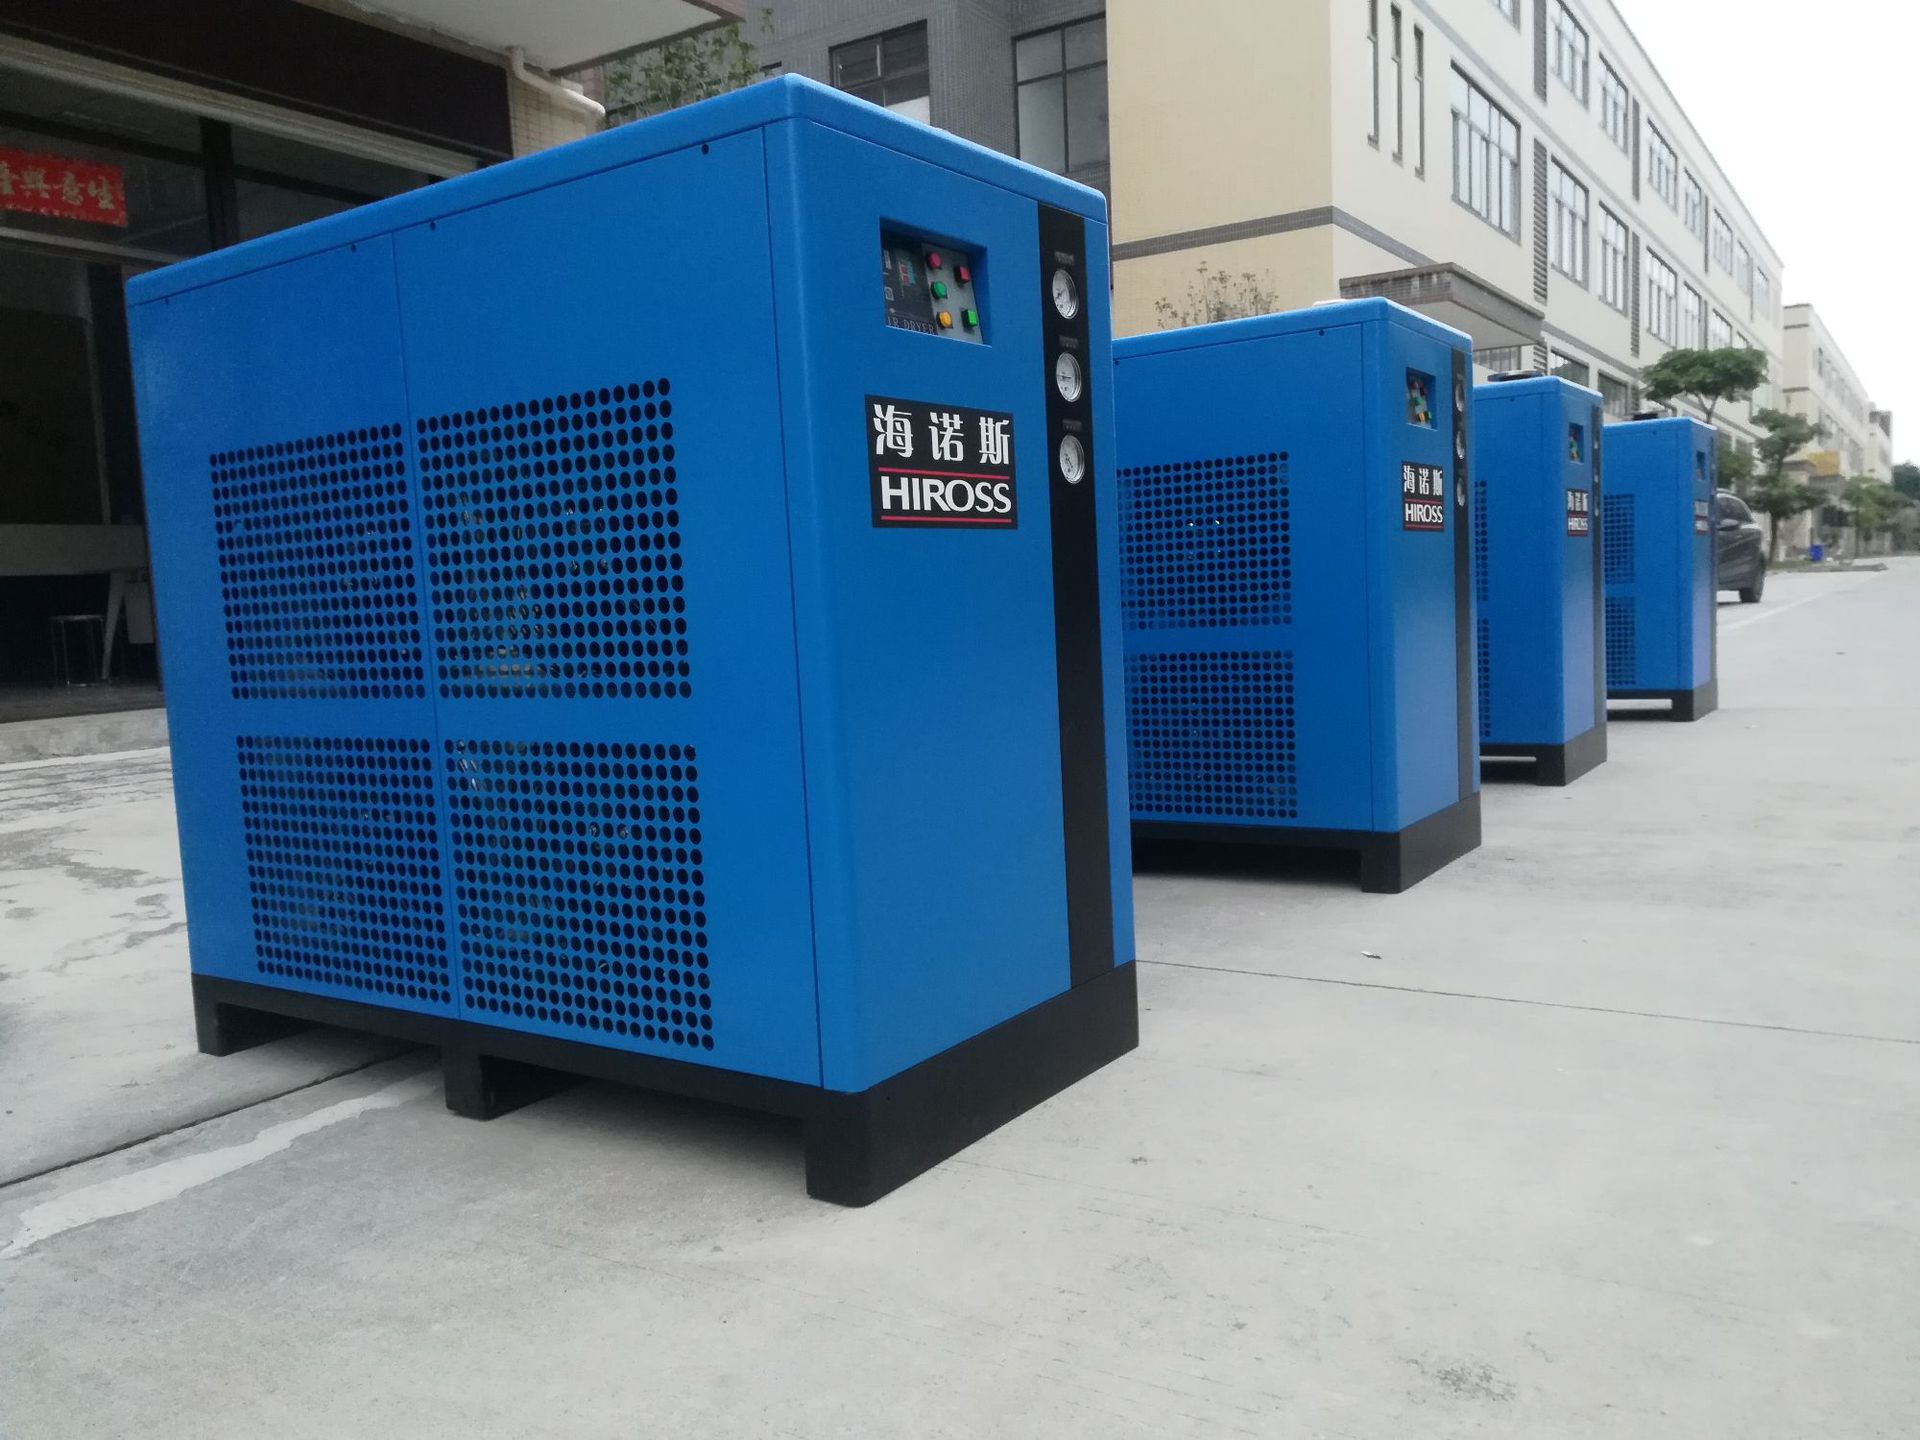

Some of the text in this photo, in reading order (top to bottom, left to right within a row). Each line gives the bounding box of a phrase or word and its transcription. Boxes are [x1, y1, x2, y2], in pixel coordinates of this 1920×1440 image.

[873, 404, 1010, 465] 海诺斯
[881, 475, 1012, 513] HIROSS
[1403, 465, 1443, 496] 海诺斯
[1405, 503, 1443, 523] HIROSS
